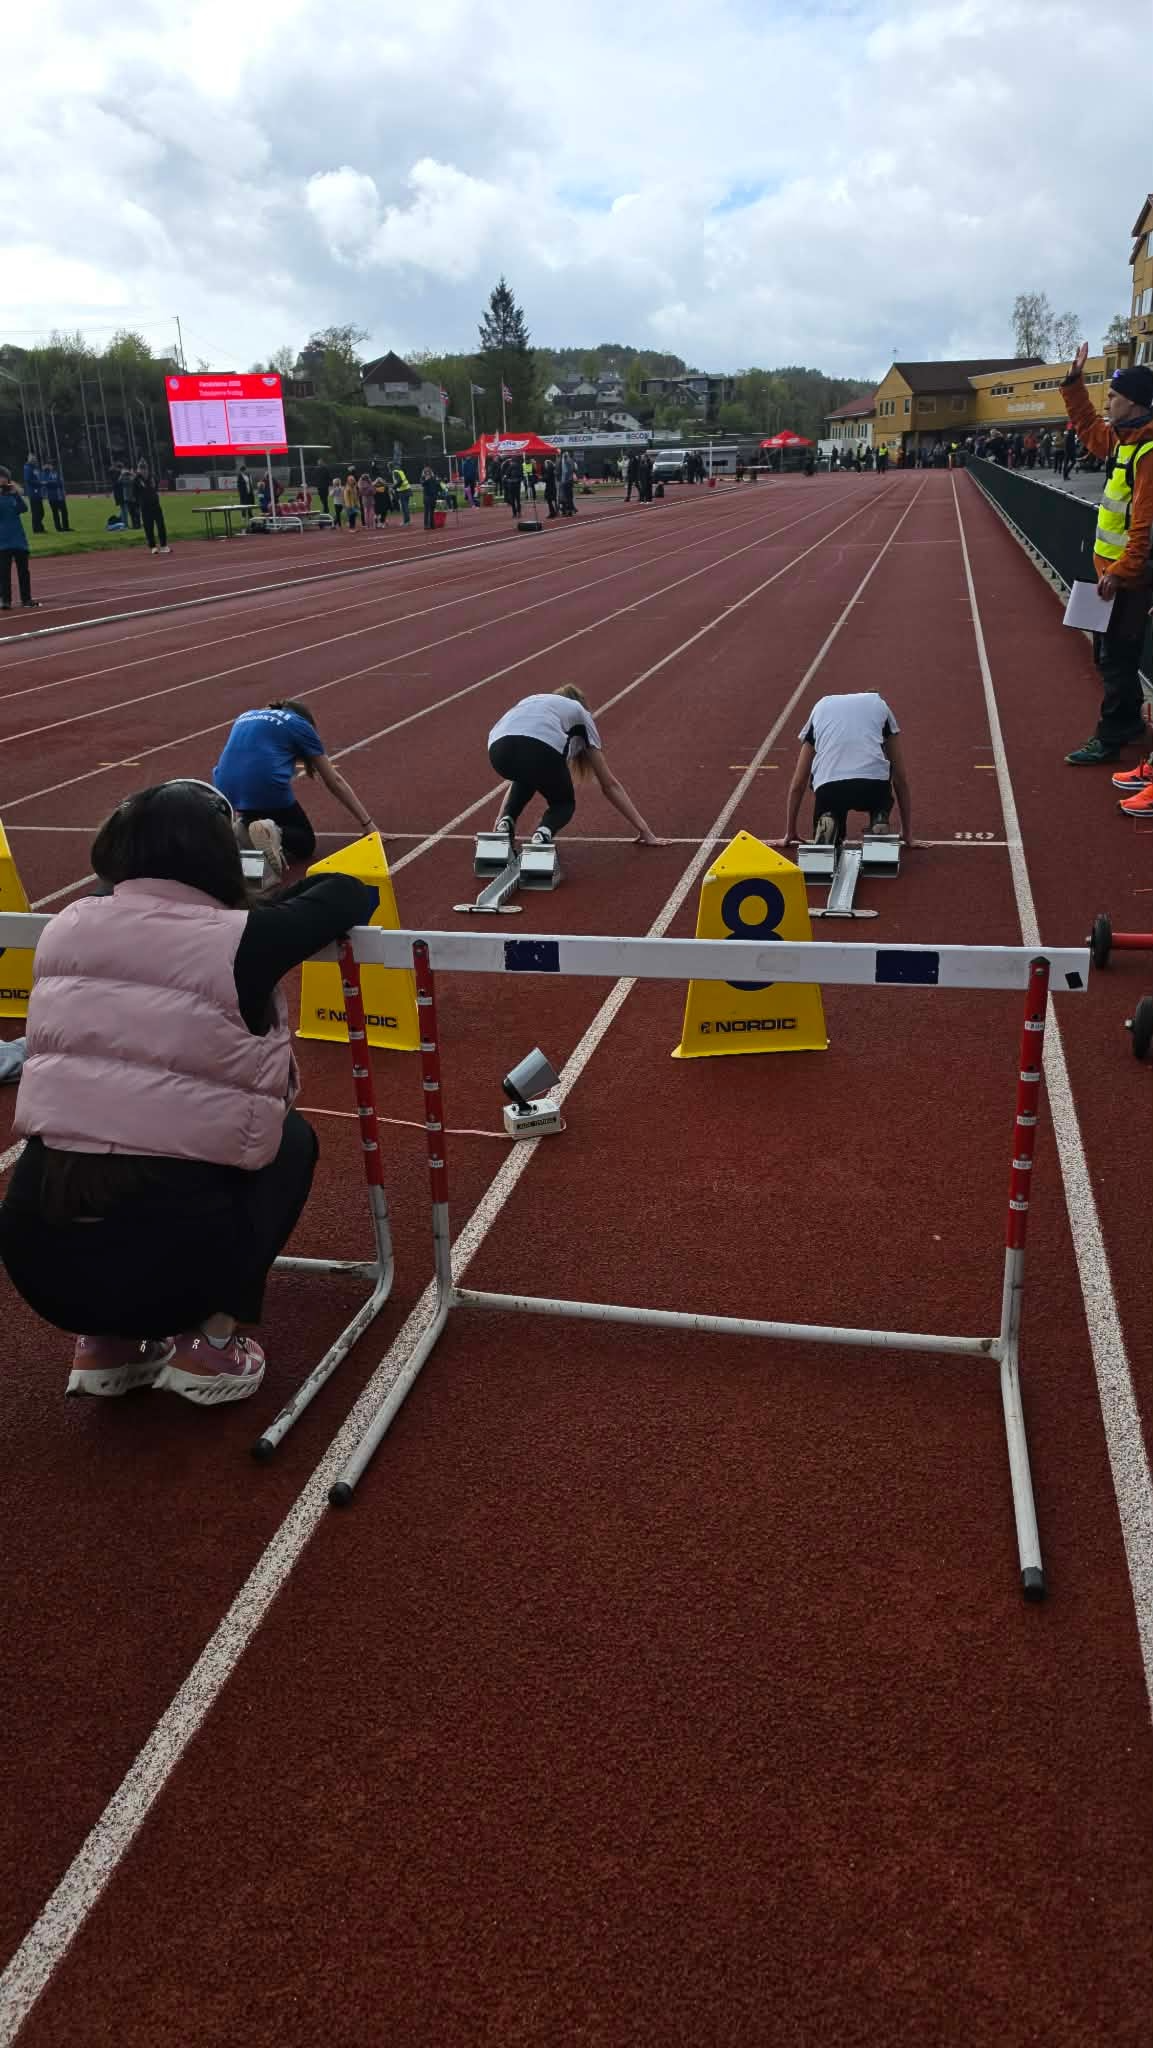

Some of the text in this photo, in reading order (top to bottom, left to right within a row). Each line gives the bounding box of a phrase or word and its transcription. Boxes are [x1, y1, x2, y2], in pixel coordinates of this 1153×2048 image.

[721, 878, 785, 991] 8
[329, 1010, 397, 1028] NDIC
[715, 1018, 796, 1032] NORDIC
